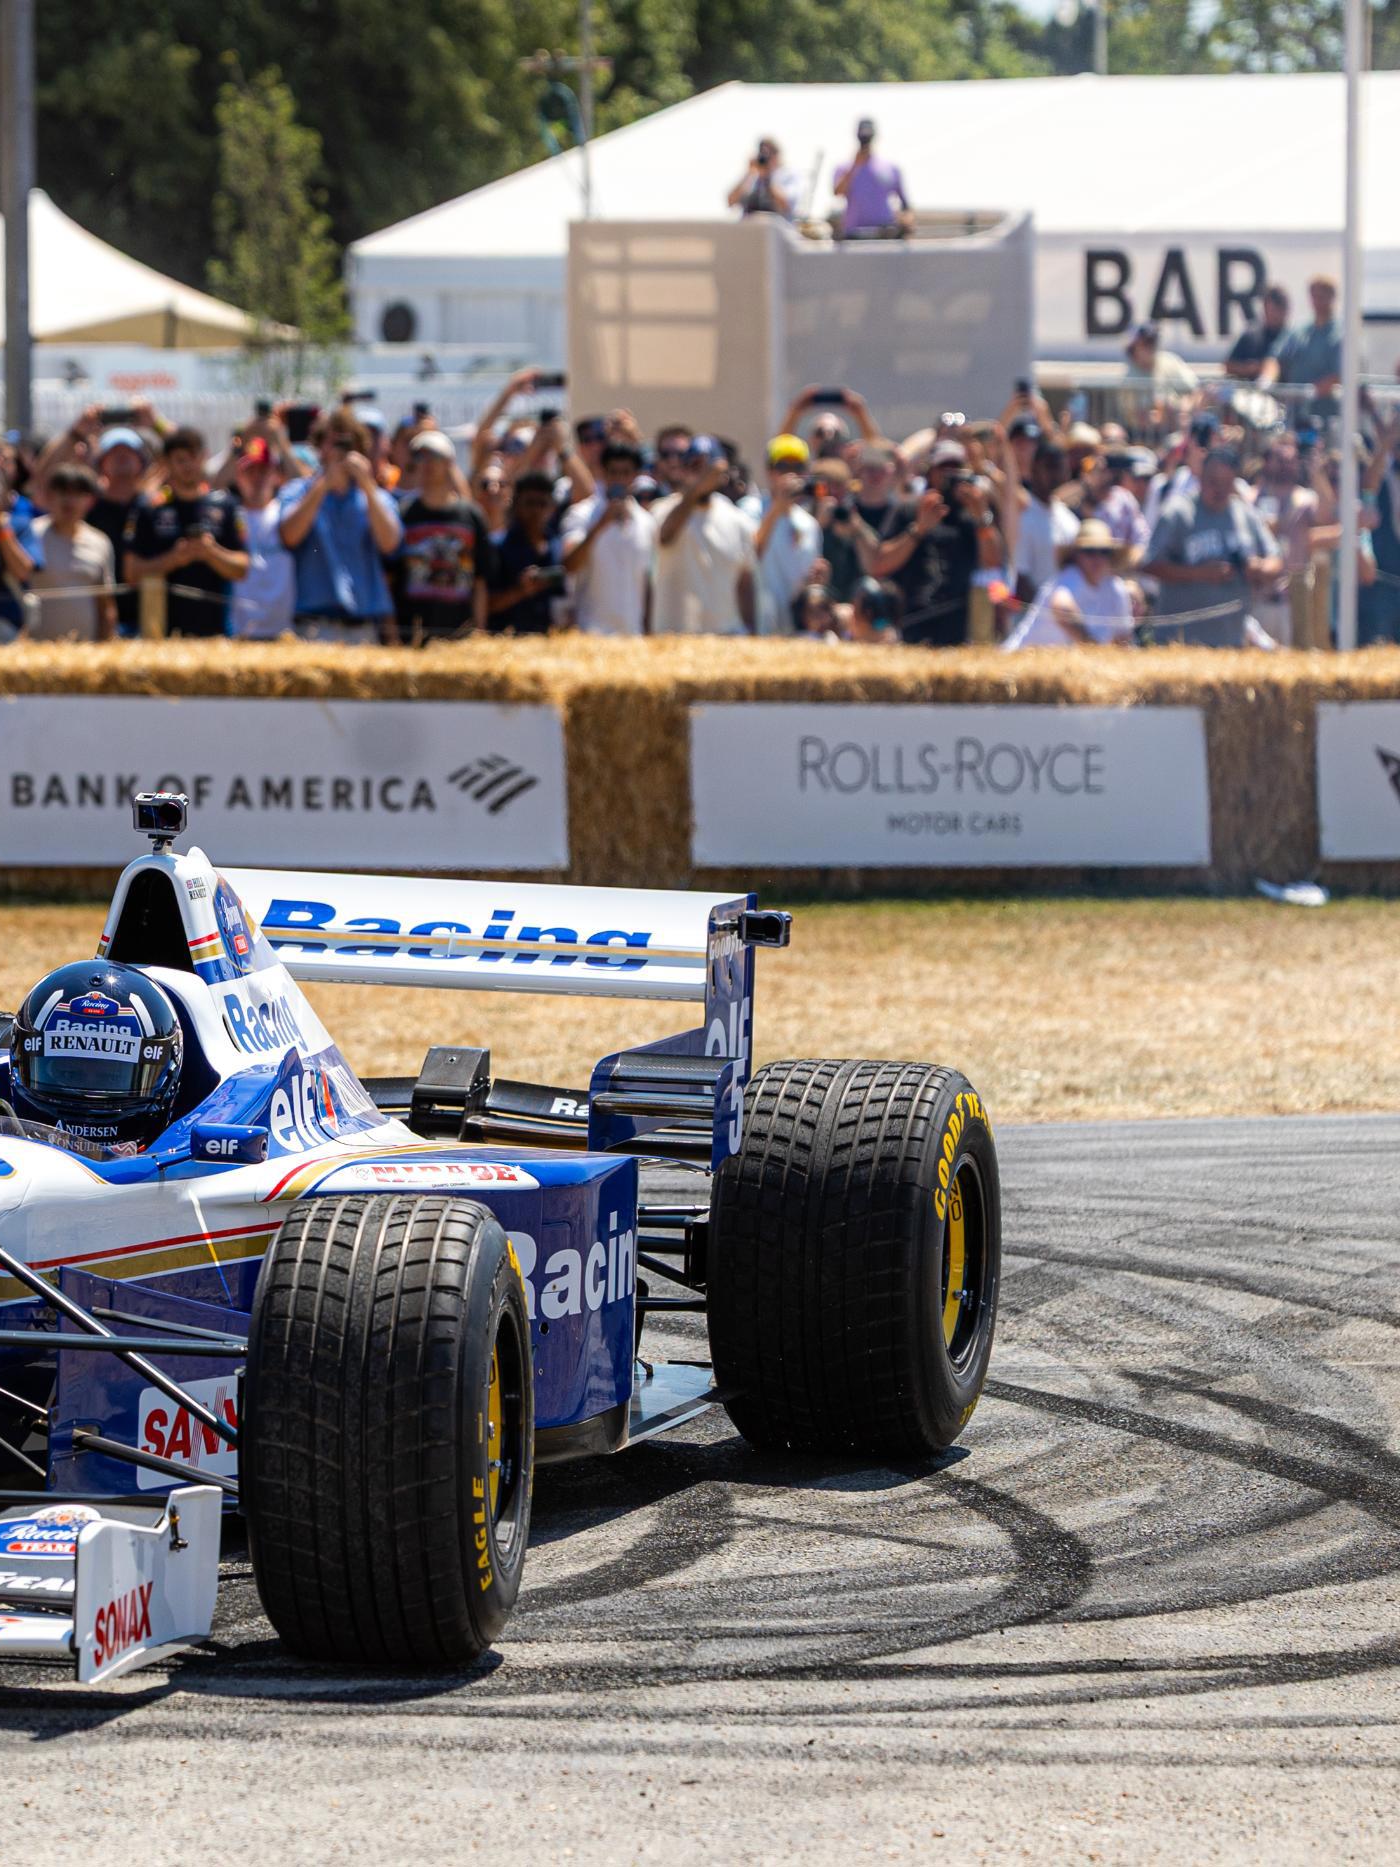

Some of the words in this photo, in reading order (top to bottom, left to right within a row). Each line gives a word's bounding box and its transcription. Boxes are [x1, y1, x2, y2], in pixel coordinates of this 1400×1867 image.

[1084, 247, 1269, 338] BAR
[800, 735, 1104, 794] ROLLS-ROYCE
[10, 771, 138, 809] BANK
[225, 774, 437, 813] AMERICA
[886, 812, 962, 835] MOTOR
[969, 813, 1022, 836] CARS
[260, 898, 653, 972] Racing
[24, 1037, 43, 1051] elf
[51, 1036, 136, 1056] RENAULT
[56, 1019, 131, 1036] Racing
[223, 993, 309, 1053] Racing
[143, 1046, 164, 1060] elf
[55, 1120, 119, 1137] ANDERSEN
[270, 1070, 328, 1152] elf
[729, 1058, 745, 1155] 5
[206, 1139, 238, 1155] elf
[505, 1210, 634, 1320] Racin
[141, 1390, 238, 1465] SAN
[0, 1524, 79, 1541] Raci
[20, 1542, 71, 1552] TEAM
[473, 1476, 493, 1592] EAGLE
[93, 1581, 154, 1668] SONAX
